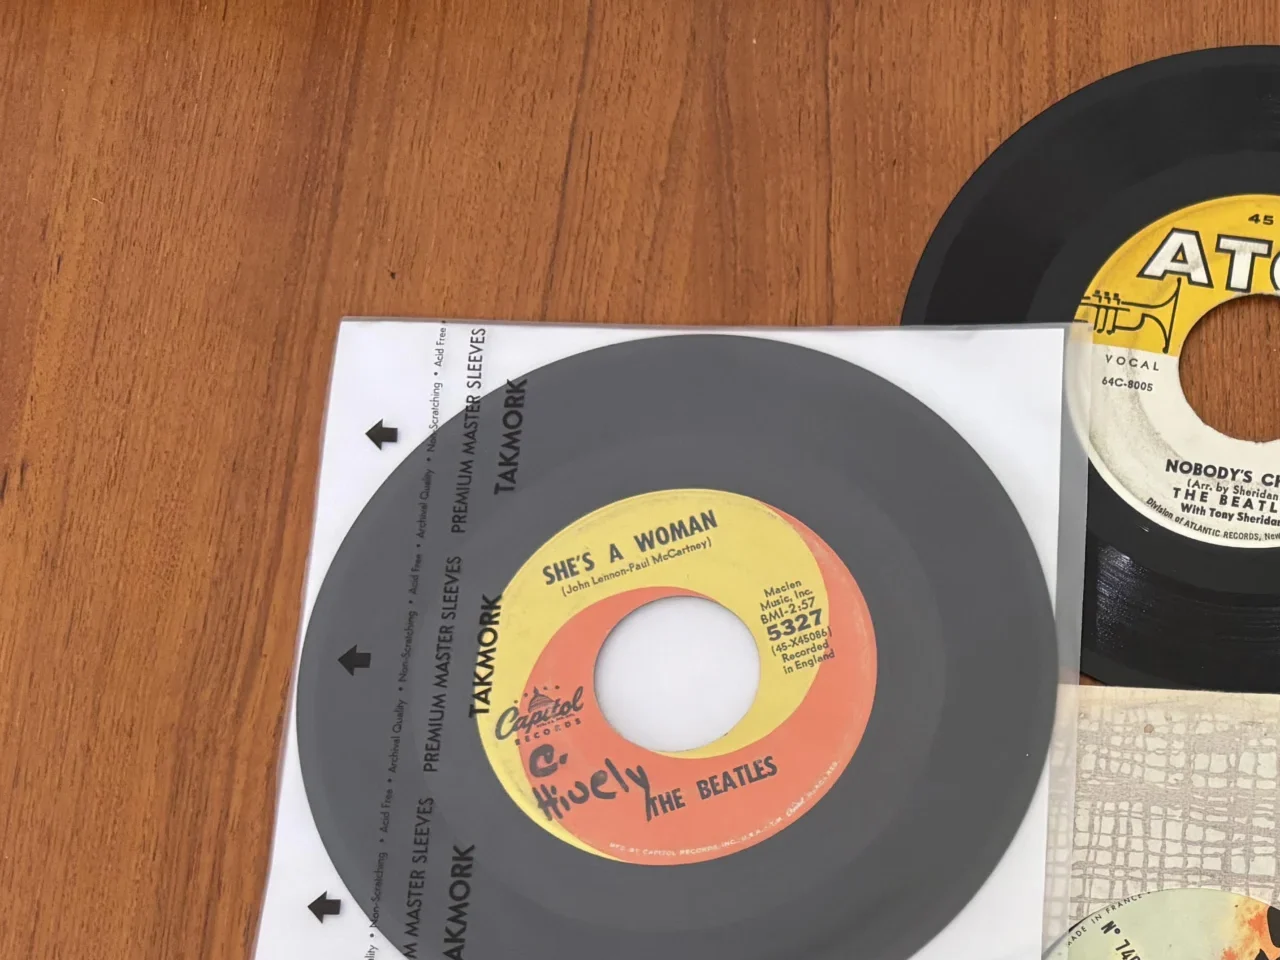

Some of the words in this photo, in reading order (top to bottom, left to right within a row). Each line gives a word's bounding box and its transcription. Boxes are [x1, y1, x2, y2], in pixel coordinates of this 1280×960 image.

[1248, 213, 1274, 226] 45
[436, 327, 446, 346] Free
[434, 349, 444, 367] Acid
[467, 328, 486, 390] SLEEVES
[1105, 355, 1159, 371] VOCAL
[1102, 376, 1153, 391] 64C-8005
[427, 382, 442, 452] Non-Scratching
[464, 395, 481, 455] MASTER
[494, 378, 527, 495] TAKMORK
[420, 468, 436, 501] Quality
[1166, 459, 1253, 483] NOBODY'S
[1187, 478, 1212, 490] (Arr.
[1216, 482, 1229, 494] by
[452, 459, 474, 533] PREMIUM
[1173, 487, 1208, 502] THE
[1181, 503, 1206, 515] With
[1210, 507, 1235, 521] Tony
[416, 502, 426, 538] Archival
[1146, 497, 1173, 520] Division
[1184, 519, 1220, 537] ATLANTIC
[1223, 531, 1262, 541] RECORDS,
[1264, 531, 1280, 540] New
[542, 552, 595, 585] SHE'S
[609, 544, 624, 563] A
[634, 510, 718, 552] WOMAN
[561, 575, 590, 597] (John
[590, 557, 650, 587] Lennon-Paul
[652, 536, 713, 567] McCartney)
[442, 556, 462, 620] SLEEVES
[760, 592, 792, 611] Music,
[793, 587, 813, 603] Inc.
[763, 580, 803, 598] Maclen
[760, 597, 816, 624] BMI-2:57
[767, 609, 823, 641] 5327
[399, 610, 417, 682] Non-Scratching
[434, 623, 454, 689] MASTER
[469, 594, 502, 719] TAKMORK
[771, 626, 833, 656] (45-X45086)
[781, 641, 829, 663] Recorded
[783, 664, 793, 674] in
[795, 650, 835, 673] England
[392, 698, 408, 733] Quality
[495, 686, 583, 740] Capitol
[424, 694, 445, 772] PREMIUM
[532, 758, 652, 822] Hively
[647, 788, 685, 816] THE
[696, 755, 778, 801] BEATLES
[412, 798, 434, 863] SLEEVES
[369, 852, 388, 927] Non-Scratching
[404, 869, 426, 937] MASTER
[1091, 914, 1102, 923] IN
[1106, 894, 1142, 914] FRANCE
